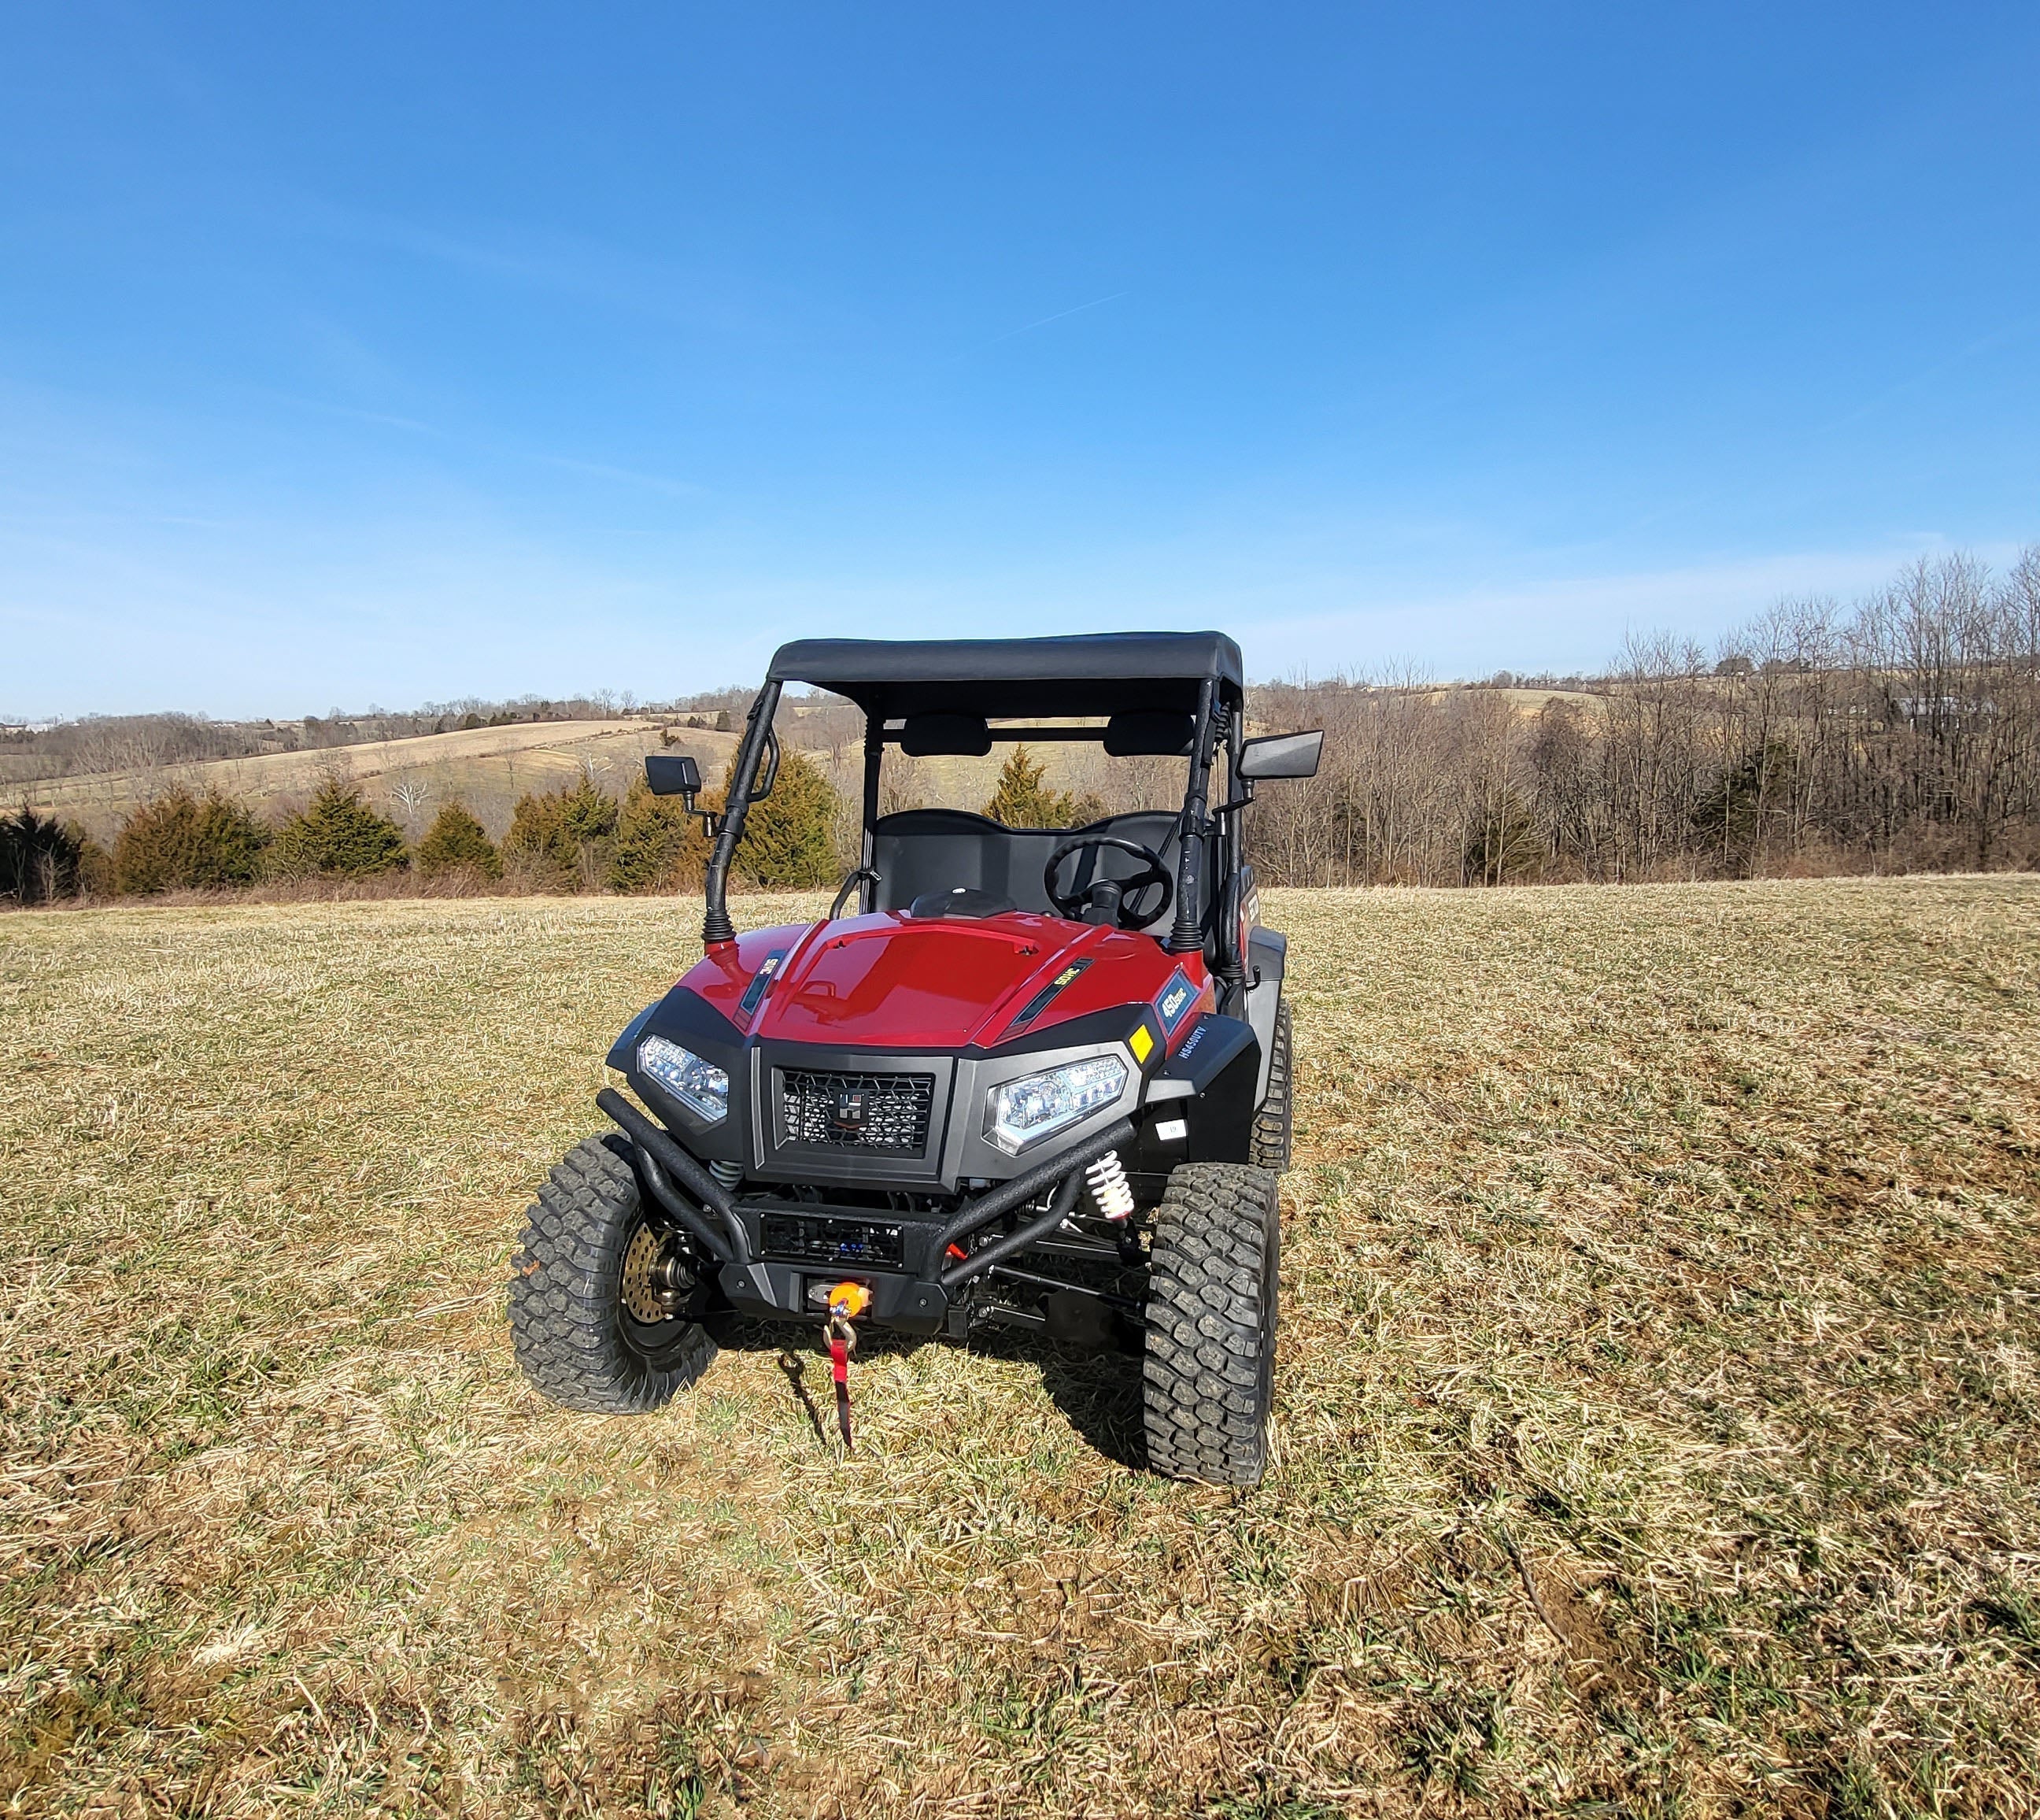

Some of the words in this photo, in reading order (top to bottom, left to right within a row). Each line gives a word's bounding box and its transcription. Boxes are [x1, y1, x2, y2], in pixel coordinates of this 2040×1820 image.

[759, 958, 778, 975] SOHC
[1054, 967, 1081, 986] SOHC
[1178, 1026, 1207, 1060] HS450UTV
